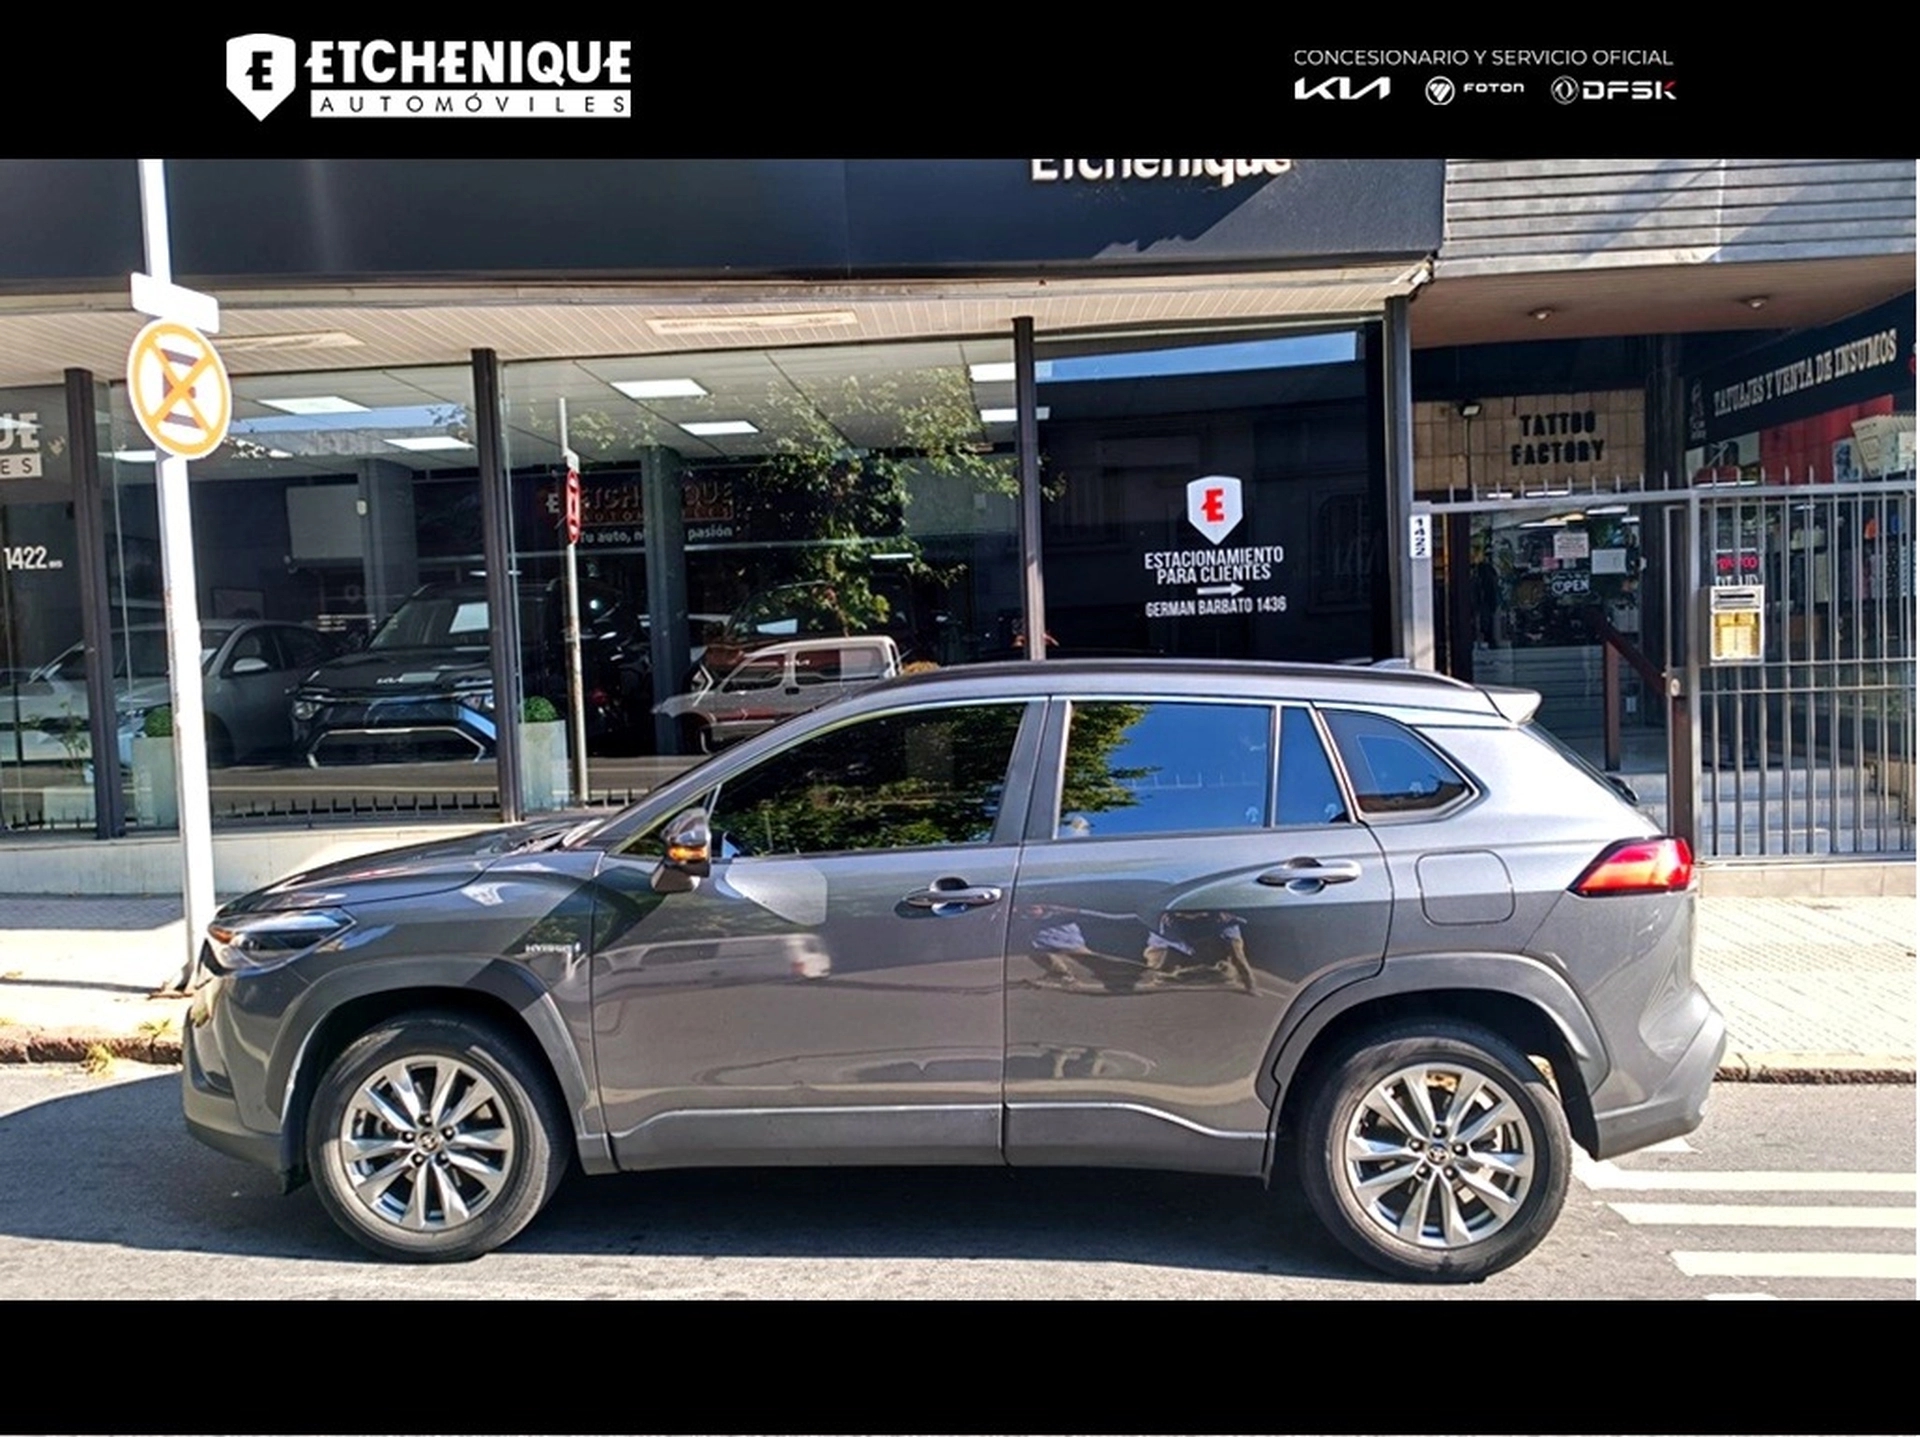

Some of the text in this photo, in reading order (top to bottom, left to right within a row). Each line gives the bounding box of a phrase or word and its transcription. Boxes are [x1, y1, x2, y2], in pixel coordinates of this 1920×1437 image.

[1713, 328, 1897, 417] TATUAJES Y VENTA DE INSUMOS
[1519, 410, 1596, 436] TATTOO
[1511, 438, 1605, 466] FACTORY
[1201, 488, 1225, 522] E
[688, 526, 733, 541] pasión
[1415, 518, 1426, 556] 1422
[3, 546, 48, 571] 1422
[1144, 545, 1284, 570] ESTACIONAMIENTO
[1157, 563, 1272, 585] PARA CLIENTES
[1145, 600, 1196, 617] GERMAN
[1197, 597, 1253, 615] BARBATO
